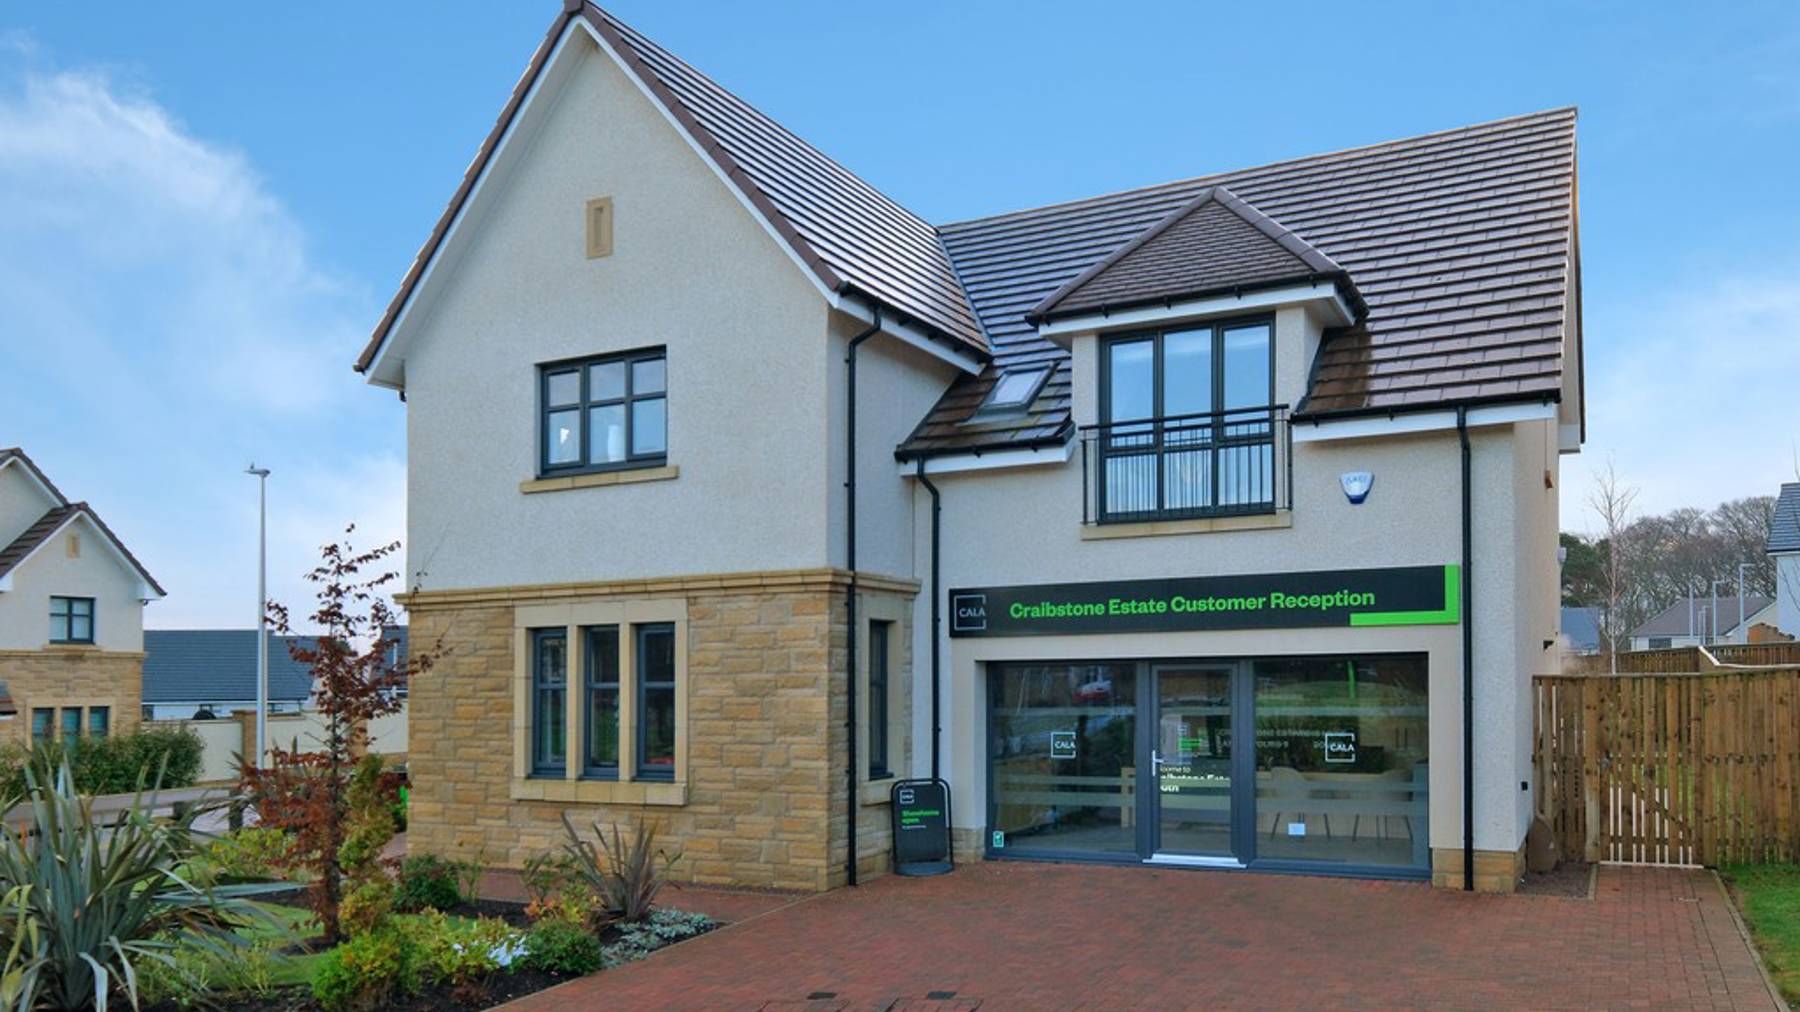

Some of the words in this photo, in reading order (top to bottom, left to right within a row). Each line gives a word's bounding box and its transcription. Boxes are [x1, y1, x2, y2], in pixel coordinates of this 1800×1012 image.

[1010, 602, 1105, 619] Craibstone
[1109, 598, 1167, 615] Estate
[1171, 594, 1266, 613] Customer
[1270, 589, 1375, 610] Reception
[959, 607, 985, 617] CALA
[1055, 740, 1075, 749] CALA
[1330, 743, 1354, 752] CALA
